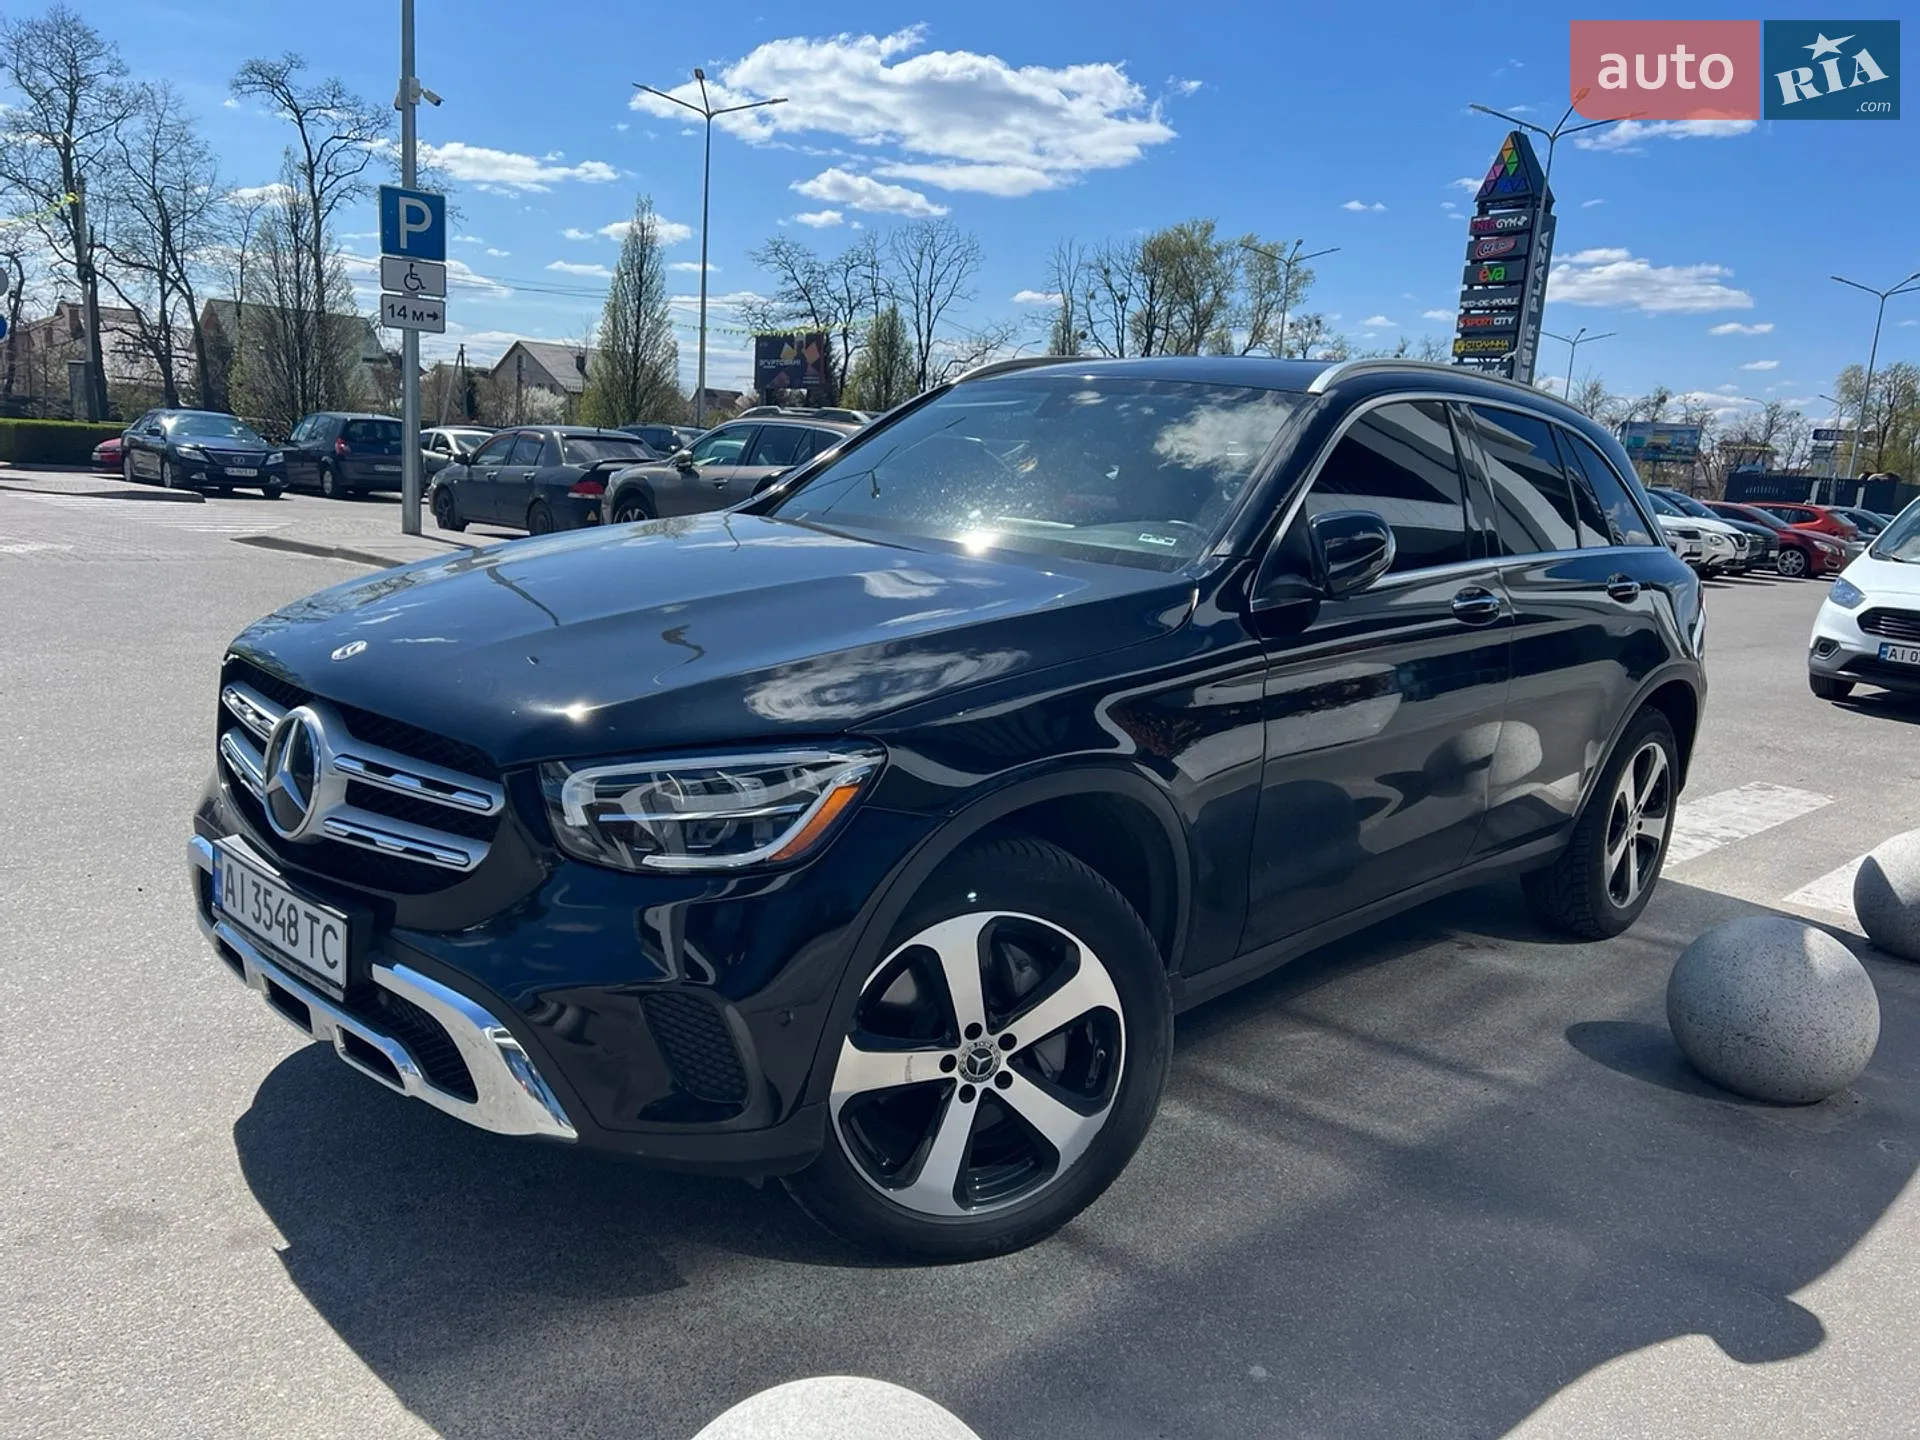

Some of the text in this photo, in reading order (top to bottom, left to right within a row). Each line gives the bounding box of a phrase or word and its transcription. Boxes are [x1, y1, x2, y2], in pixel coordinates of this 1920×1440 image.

[398, 196, 433, 249] P
[1530, 231, 1550, 313] PLAZA
[387, 303, 407, 321] 14
[251, 879, 299, 948] 3548
[303, 910, 339, 969] TC
